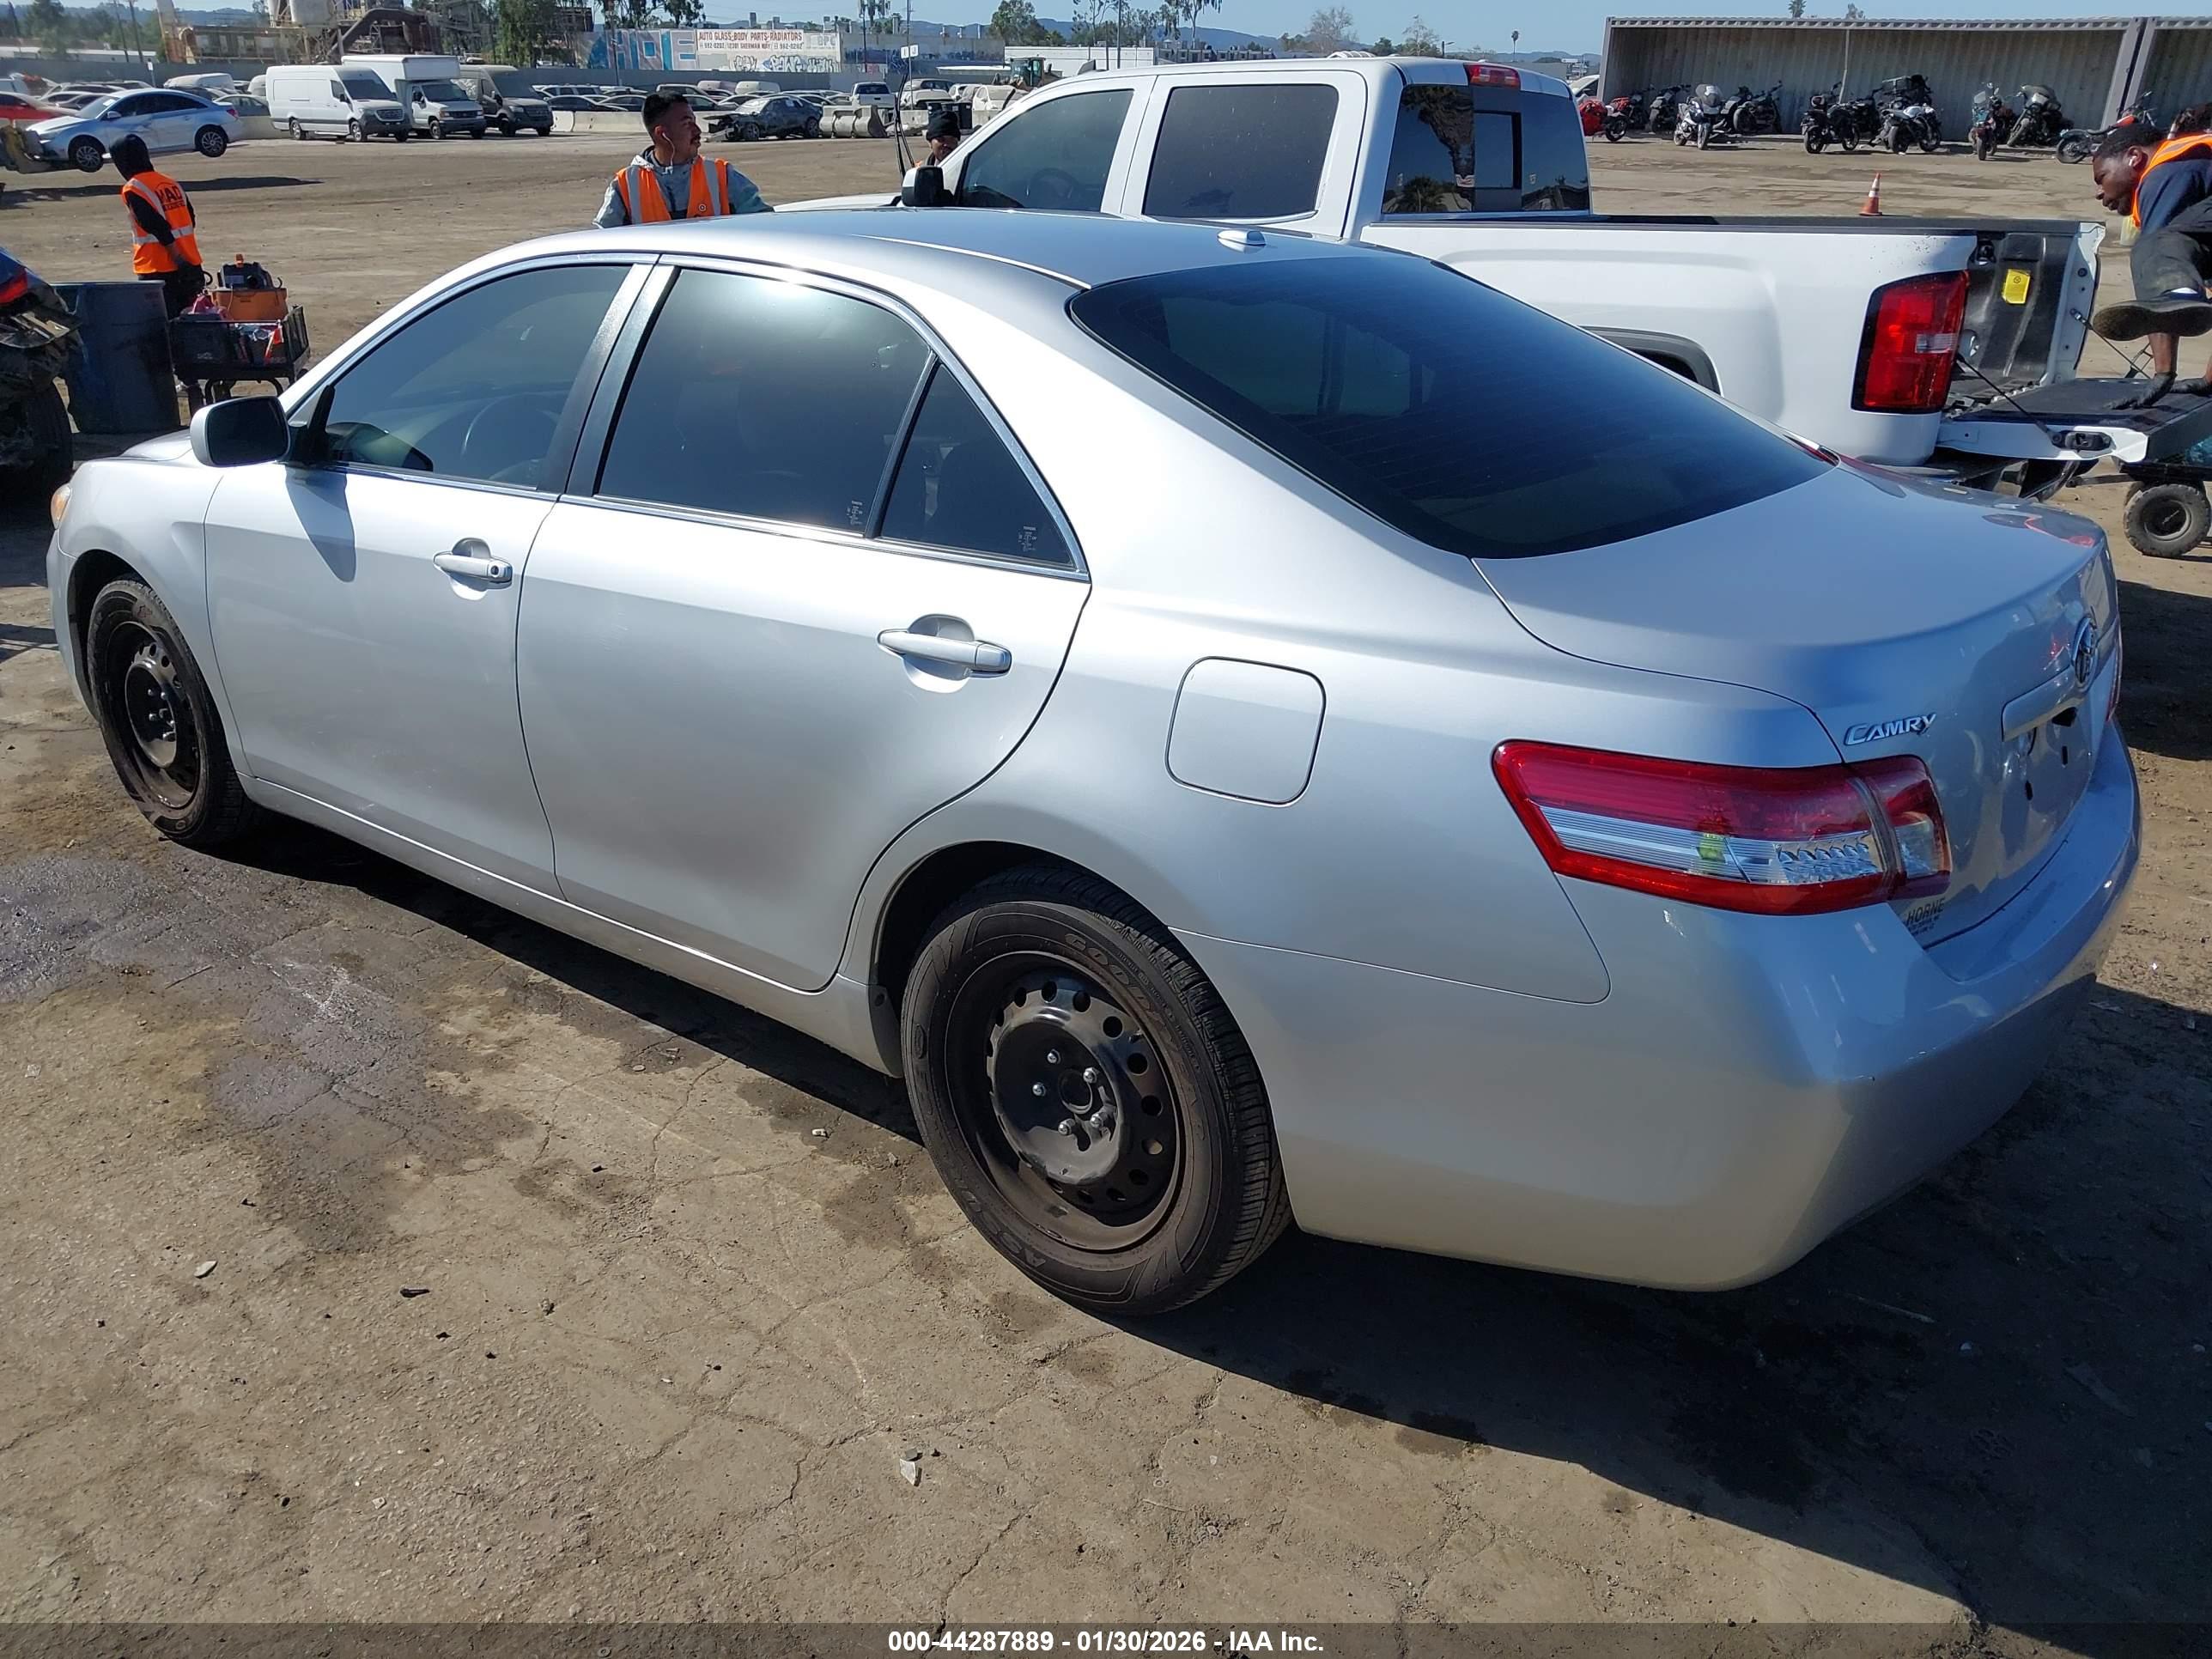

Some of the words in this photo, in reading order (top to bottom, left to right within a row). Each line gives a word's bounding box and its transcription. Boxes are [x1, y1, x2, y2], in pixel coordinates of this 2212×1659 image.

[699, 32, 713, 40] AUTO
[1844, 713, 1936, 745] CAMRY
[1064, 933, 1206, 1140] GOODYEAR
